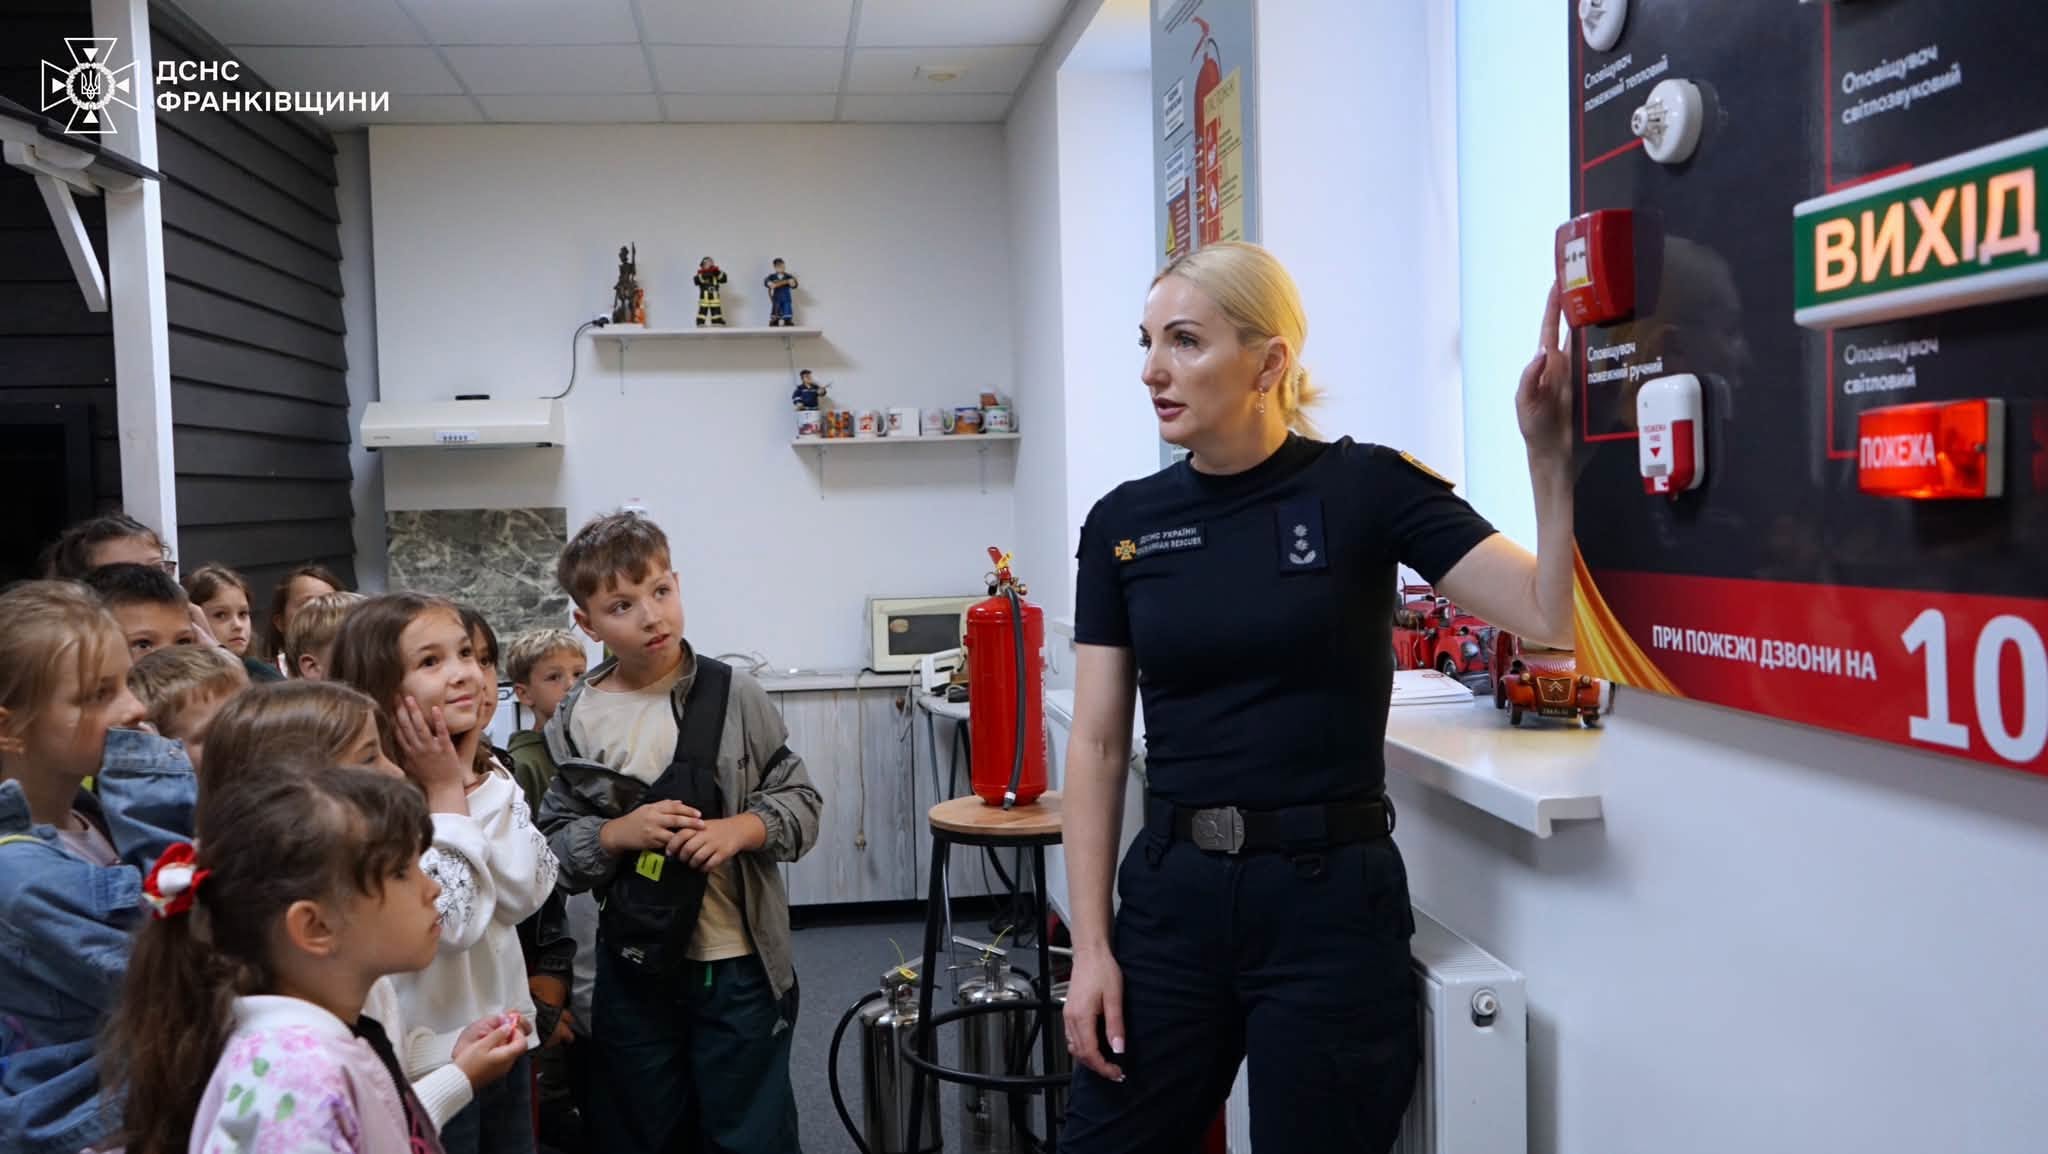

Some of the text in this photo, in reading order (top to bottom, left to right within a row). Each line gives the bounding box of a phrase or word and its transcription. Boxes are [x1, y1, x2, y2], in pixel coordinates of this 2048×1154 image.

[1842, 45, 1938, 93] Оповіщувач
[1815, 167, 2040, 293] ВИХІД
[1844, 337, 1938, 365] Оповіщувач
[1844, 367, 1916, 394] світловий
[1860, 431, 1936, 470] ПОЖЕЖА
[1652, 624, 1878, 680] ПРИ ПОЖЕЖІ ДЗВОНИ НА
